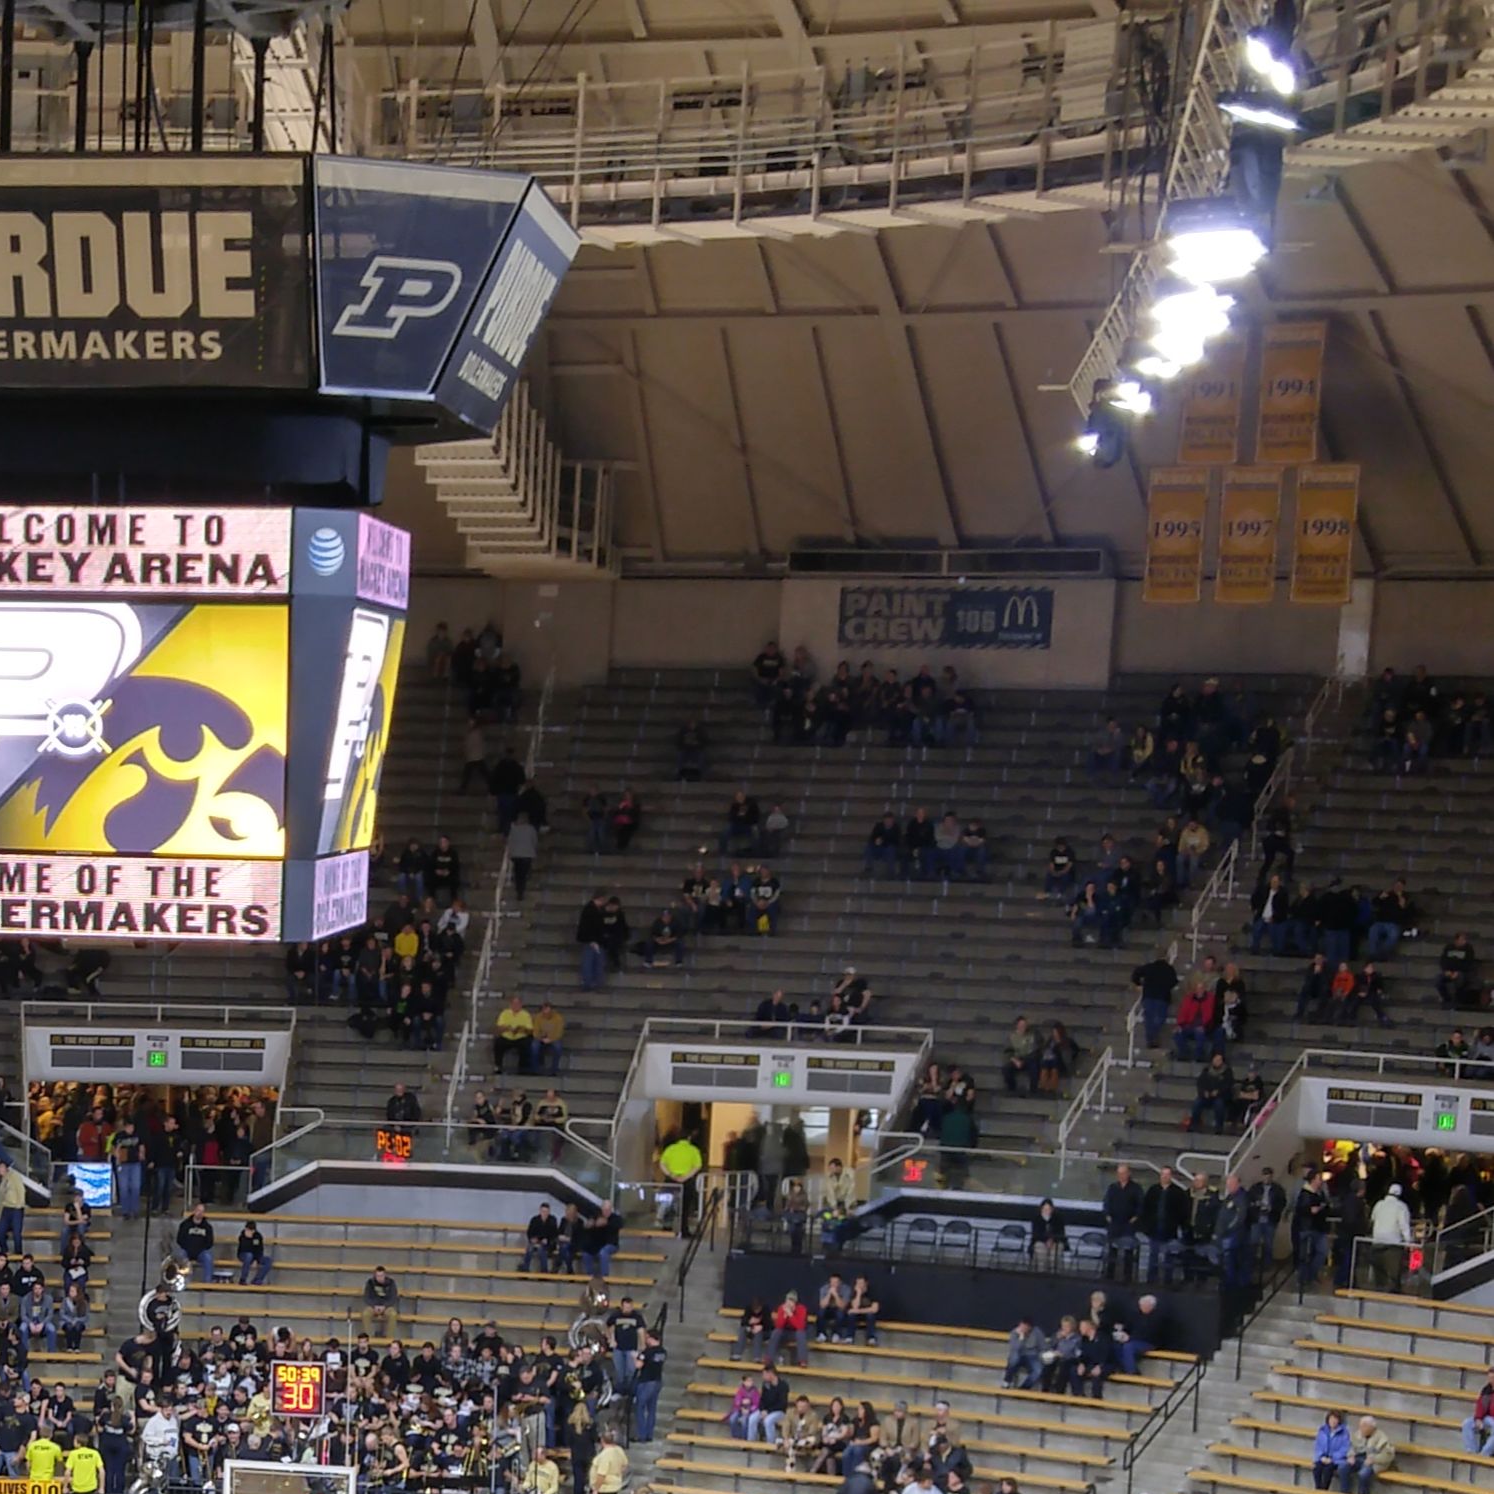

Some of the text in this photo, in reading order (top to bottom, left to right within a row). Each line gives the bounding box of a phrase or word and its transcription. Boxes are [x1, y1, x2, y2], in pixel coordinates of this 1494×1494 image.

[332, 256, 463, 338] P
[173, 513, 226, 546] TO
[103, 552, 279, 588] ARENA
[846, 592, 950, 617] PAINT
[844, 617, 946, 641] CREW
[76, 861, 123, 896] OF
[149, 863, 222, 898] THE
[277, 1365, 321, 1383] 50:39
[283, 1383, 314, 1410] 30
